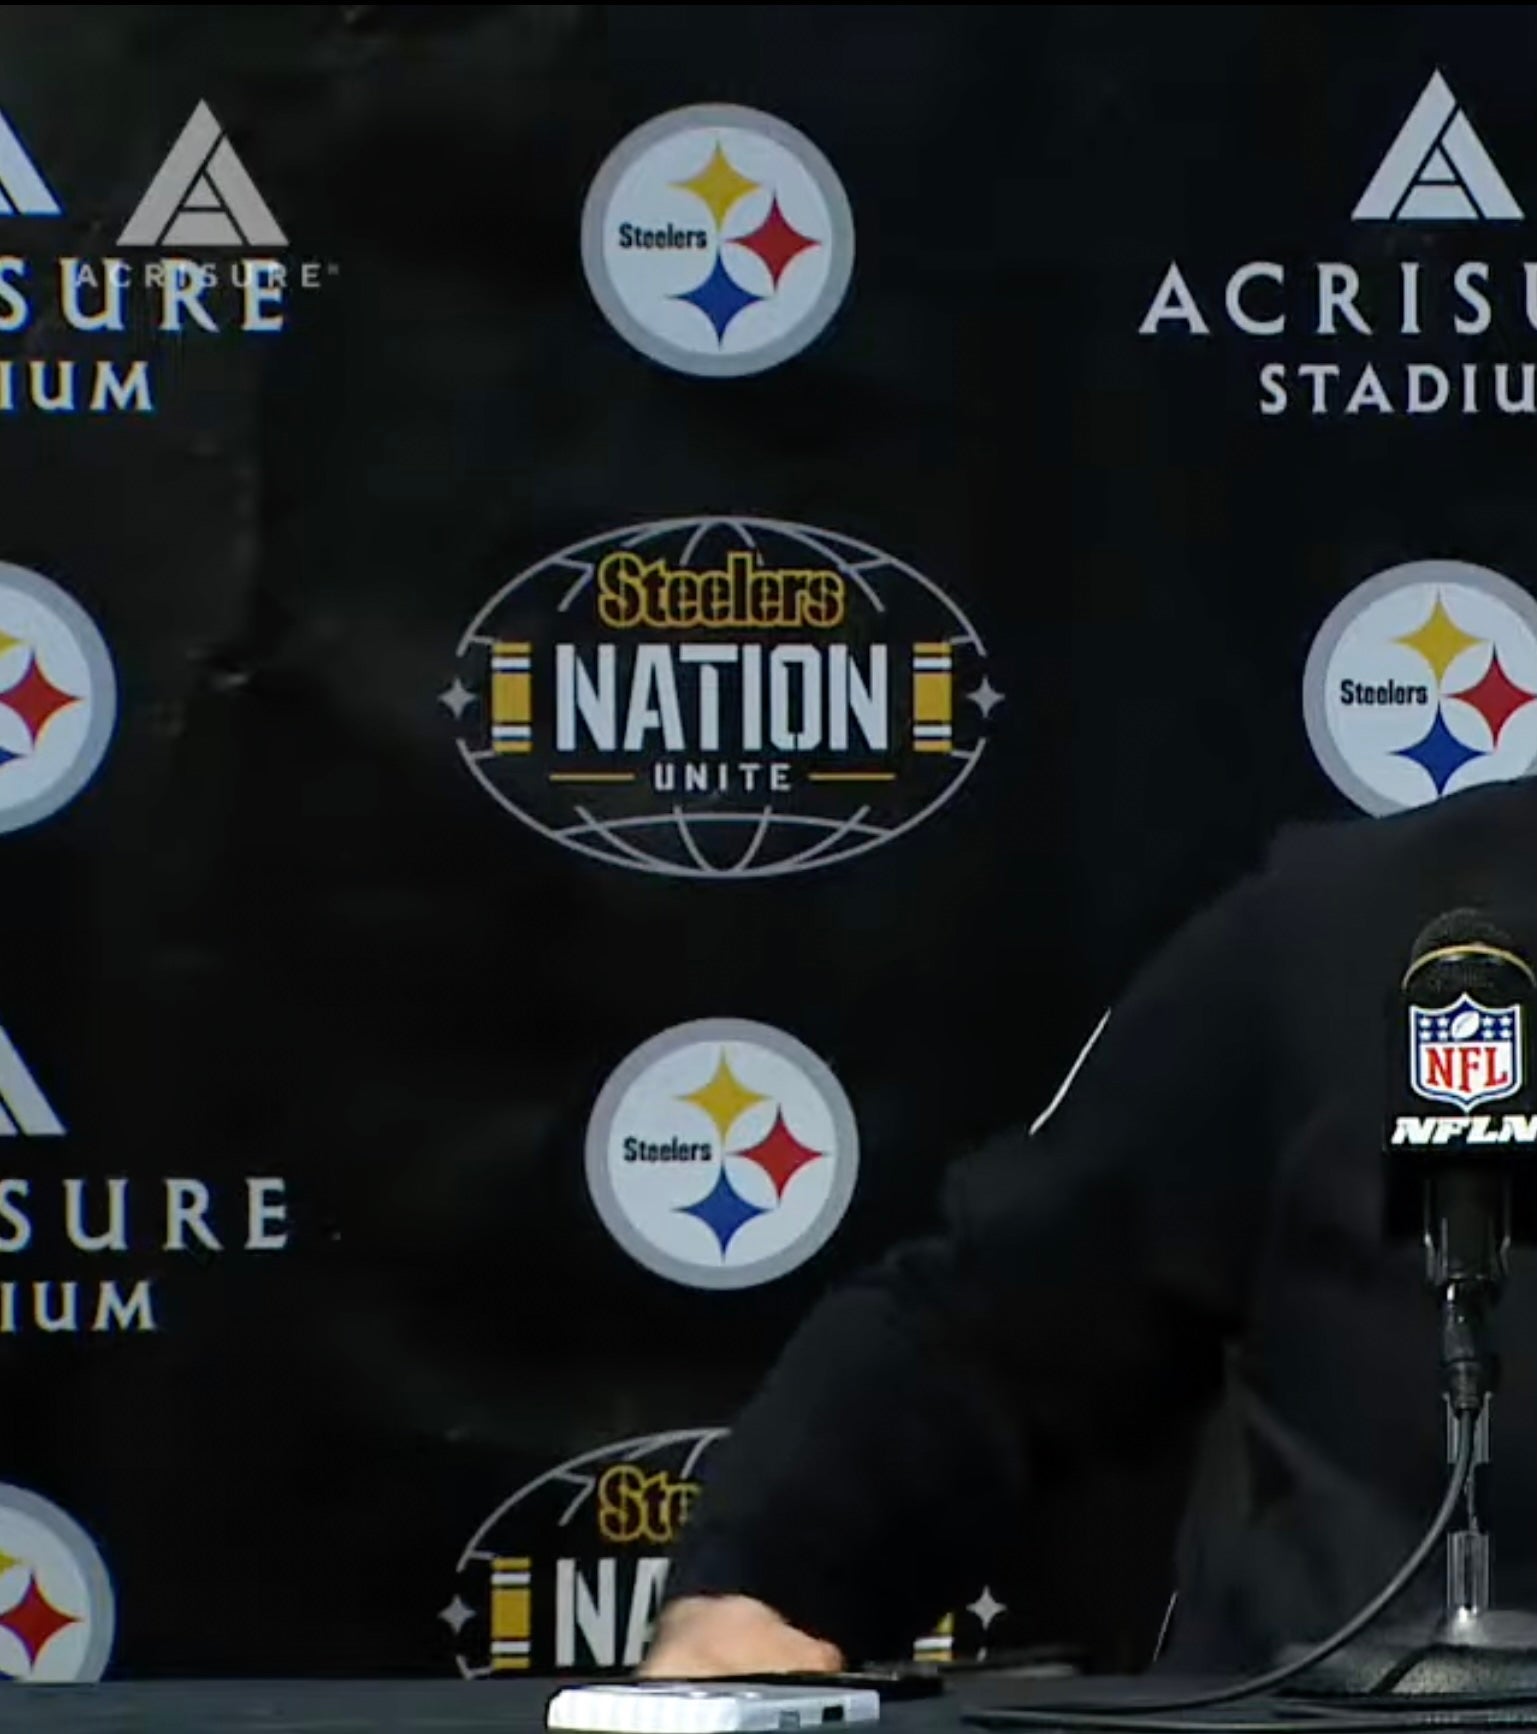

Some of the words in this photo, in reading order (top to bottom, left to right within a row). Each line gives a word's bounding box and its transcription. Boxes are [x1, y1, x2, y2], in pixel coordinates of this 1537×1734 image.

[619, 221, 707, 249] Steelers
[600, 552, 844, 629] Steelers
[556, 643, 888, 752] NATION
[1340, 679, 1428, 706] Steelers
[654, 763, 791, 791] UNITE
[1425, 1047, 1508, 1093] NFL
[622, 1136, 713, 1162] Steelers
